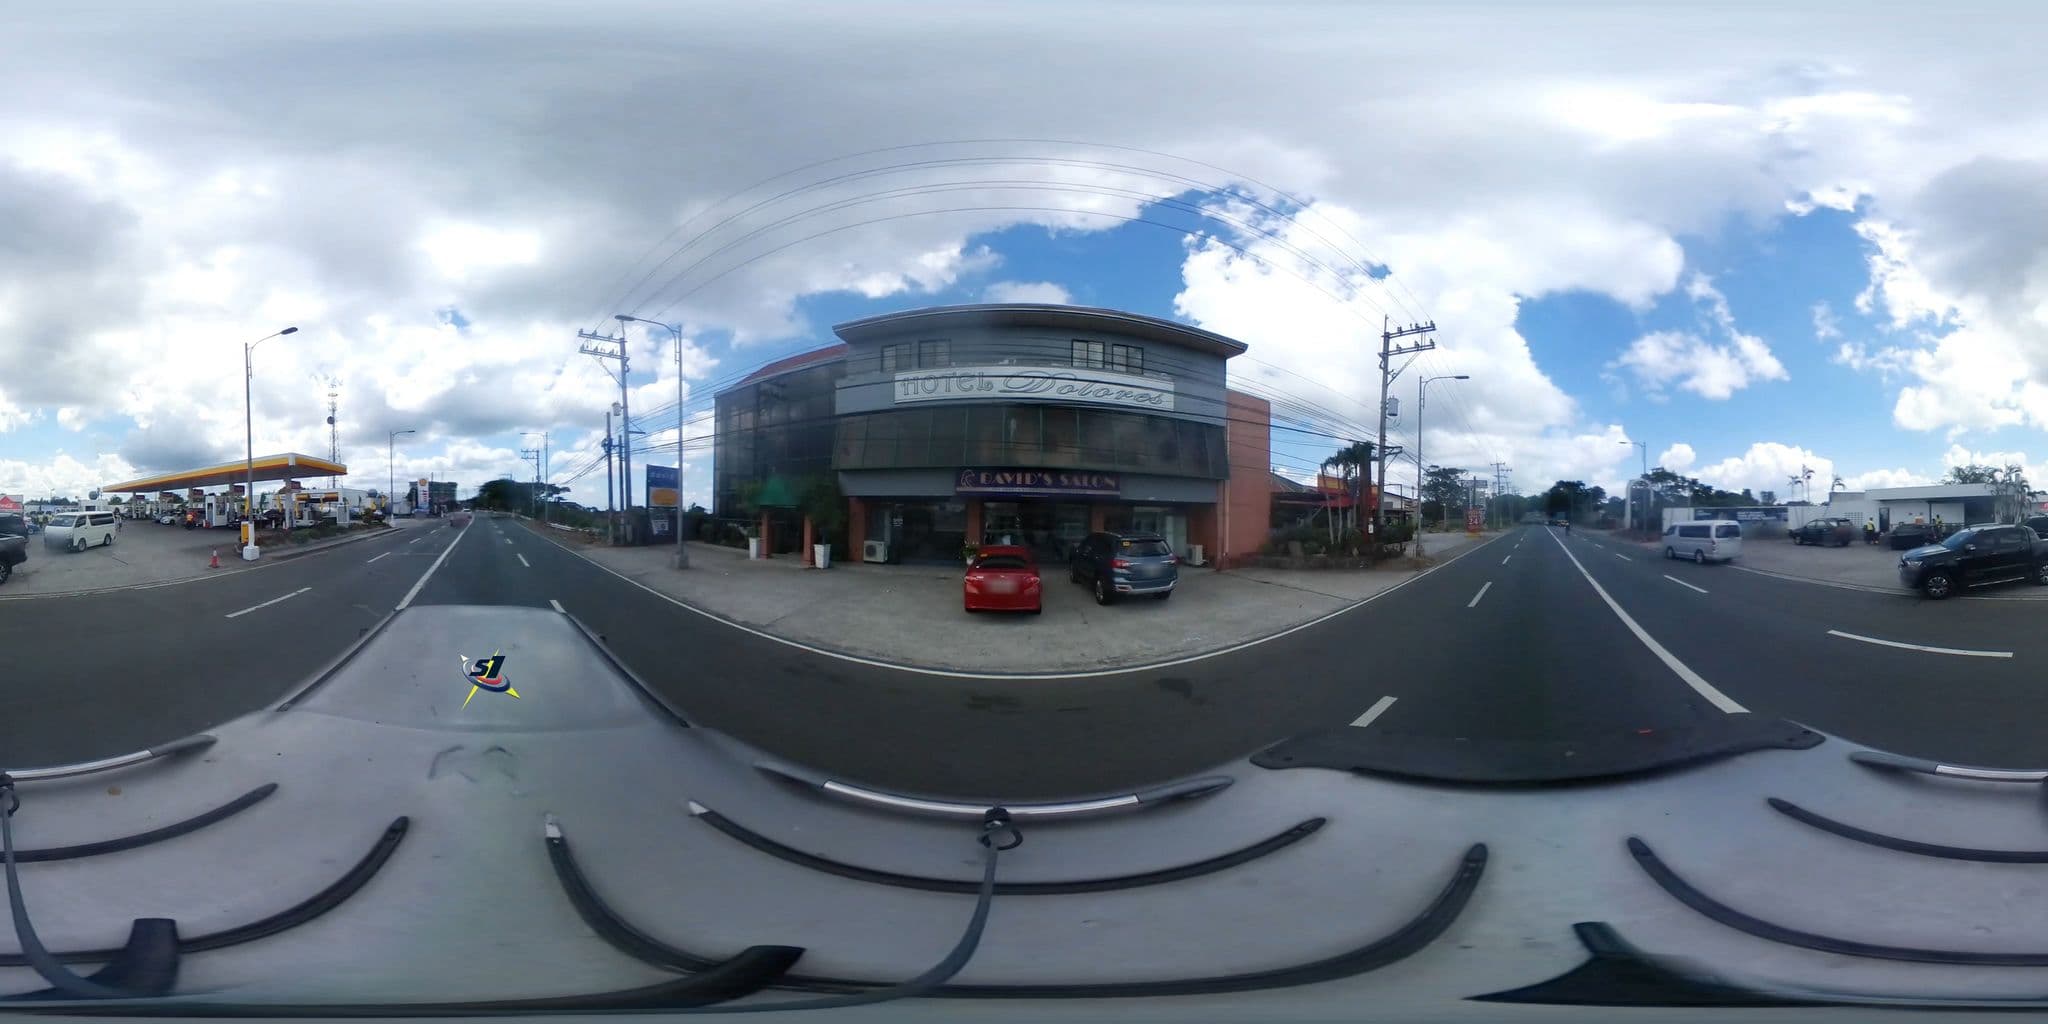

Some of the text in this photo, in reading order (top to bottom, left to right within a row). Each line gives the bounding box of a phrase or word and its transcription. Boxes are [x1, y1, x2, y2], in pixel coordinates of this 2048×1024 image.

[902, 371, 1164, 404] HOTEL Dolores
[980, 472, 1115, 488] DAVID'S SALON
